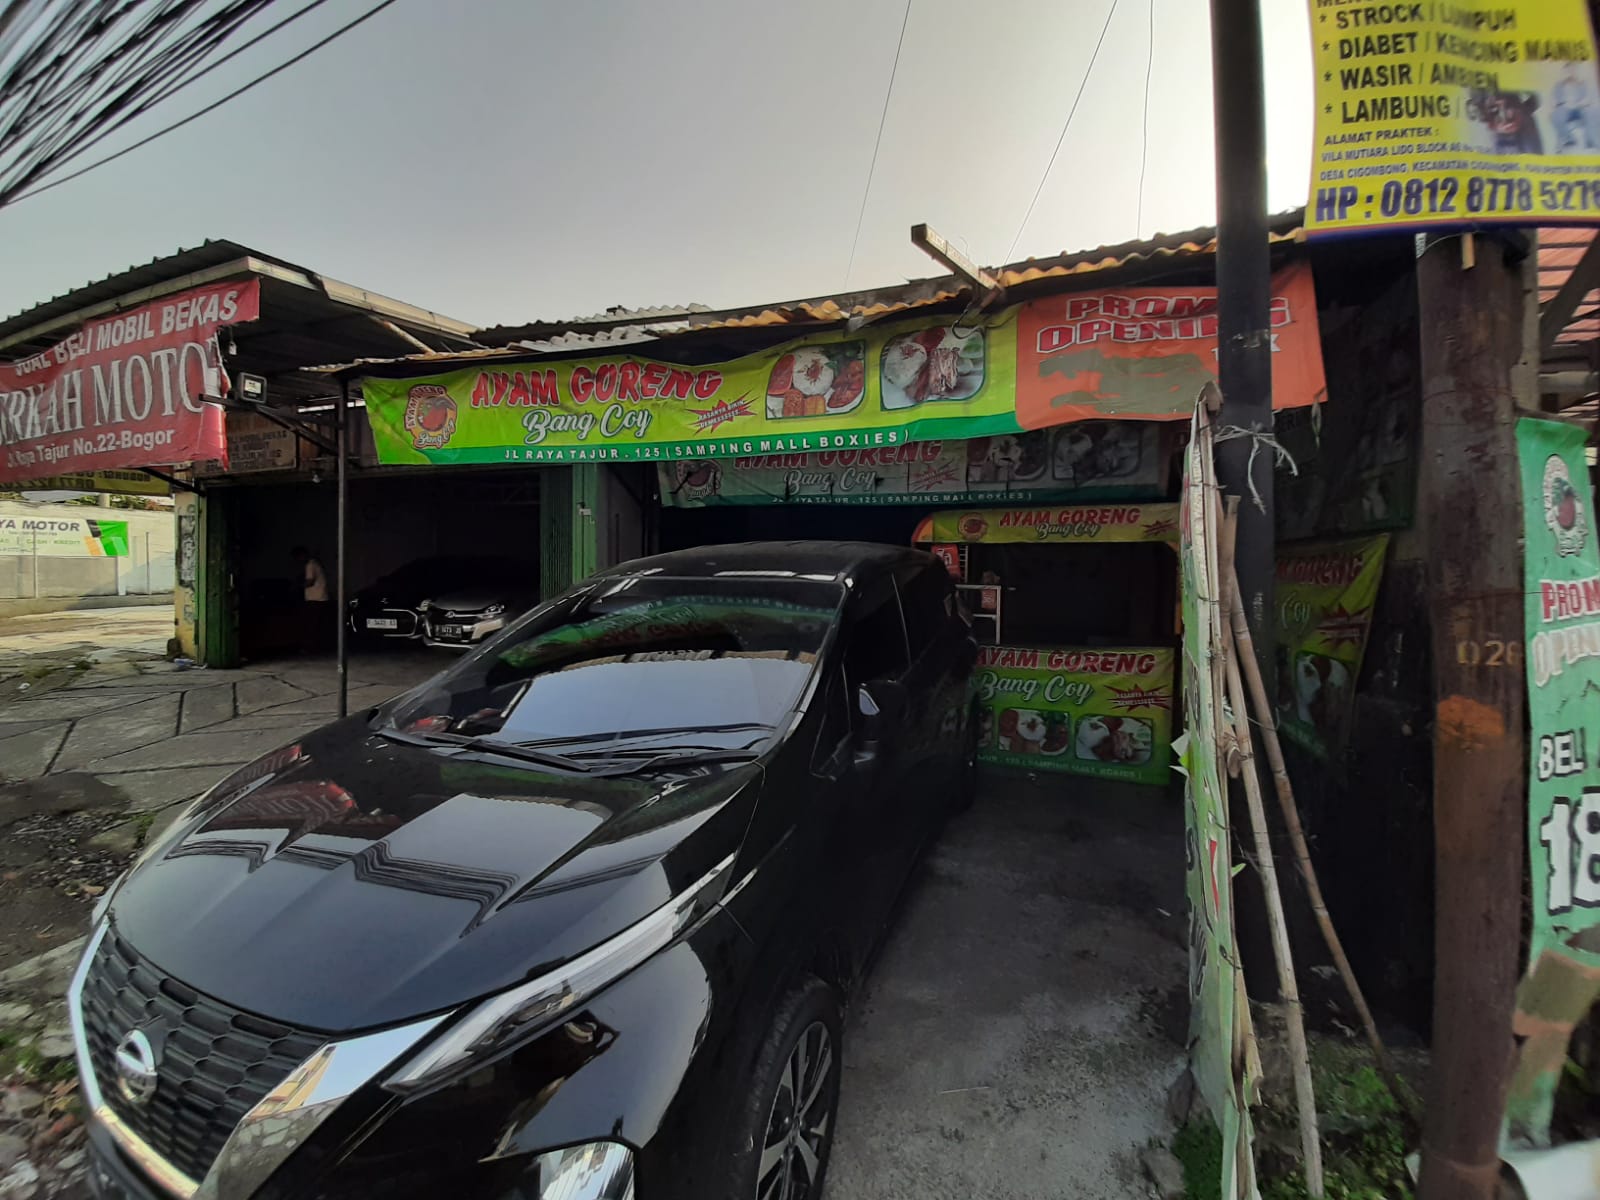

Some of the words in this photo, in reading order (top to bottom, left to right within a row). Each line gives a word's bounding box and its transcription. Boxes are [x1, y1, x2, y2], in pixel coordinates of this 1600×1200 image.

[1336, 3, 1424, 29] STROCK
[1339, 32, 1418, 59] DIABET
[1340, 63, 1413, 90] WASIR
[1341, 95, 1450, 124] LAMBUNG
[1323, 132, 1373, 146] ALAMAT
[1315, 186, 1358, 222] HP
[1380, 177, 1459, 217] 0812
[1466, 176, 1533, 214] 8778
[97, 311, 155, 352] MOBIL
[161, 290, 239, 335] BEKAS
[92, 337, 219, 427] MOTO
[471, 368, 561, 408] AYAM
[569, 361, 724, 404] GORENG
[522, 408, 597, 446] Bang
[599, 402, 653, 438] Coy
[36, 443, 70, 465] Tajur
[504, 449, 520, 460] JL
[525, 450, 564, 460] RAYA
[569, 448, 619, 460] TAJUR
[635, 447, 661, 458] 125
[760, 437, 811, 452] MALL
[840, 467, 878, 492] Coy
[22, 520, 81, 532] MOTOR
[999, 510, 1051, 528] AYAM
[1057, 507, 1141, 527] GORENG
[1036, 522, 1072, 539] Bang
[1046, 650, 1156, 674] GORENG
[1044, 674, 1094, 705] Coy
